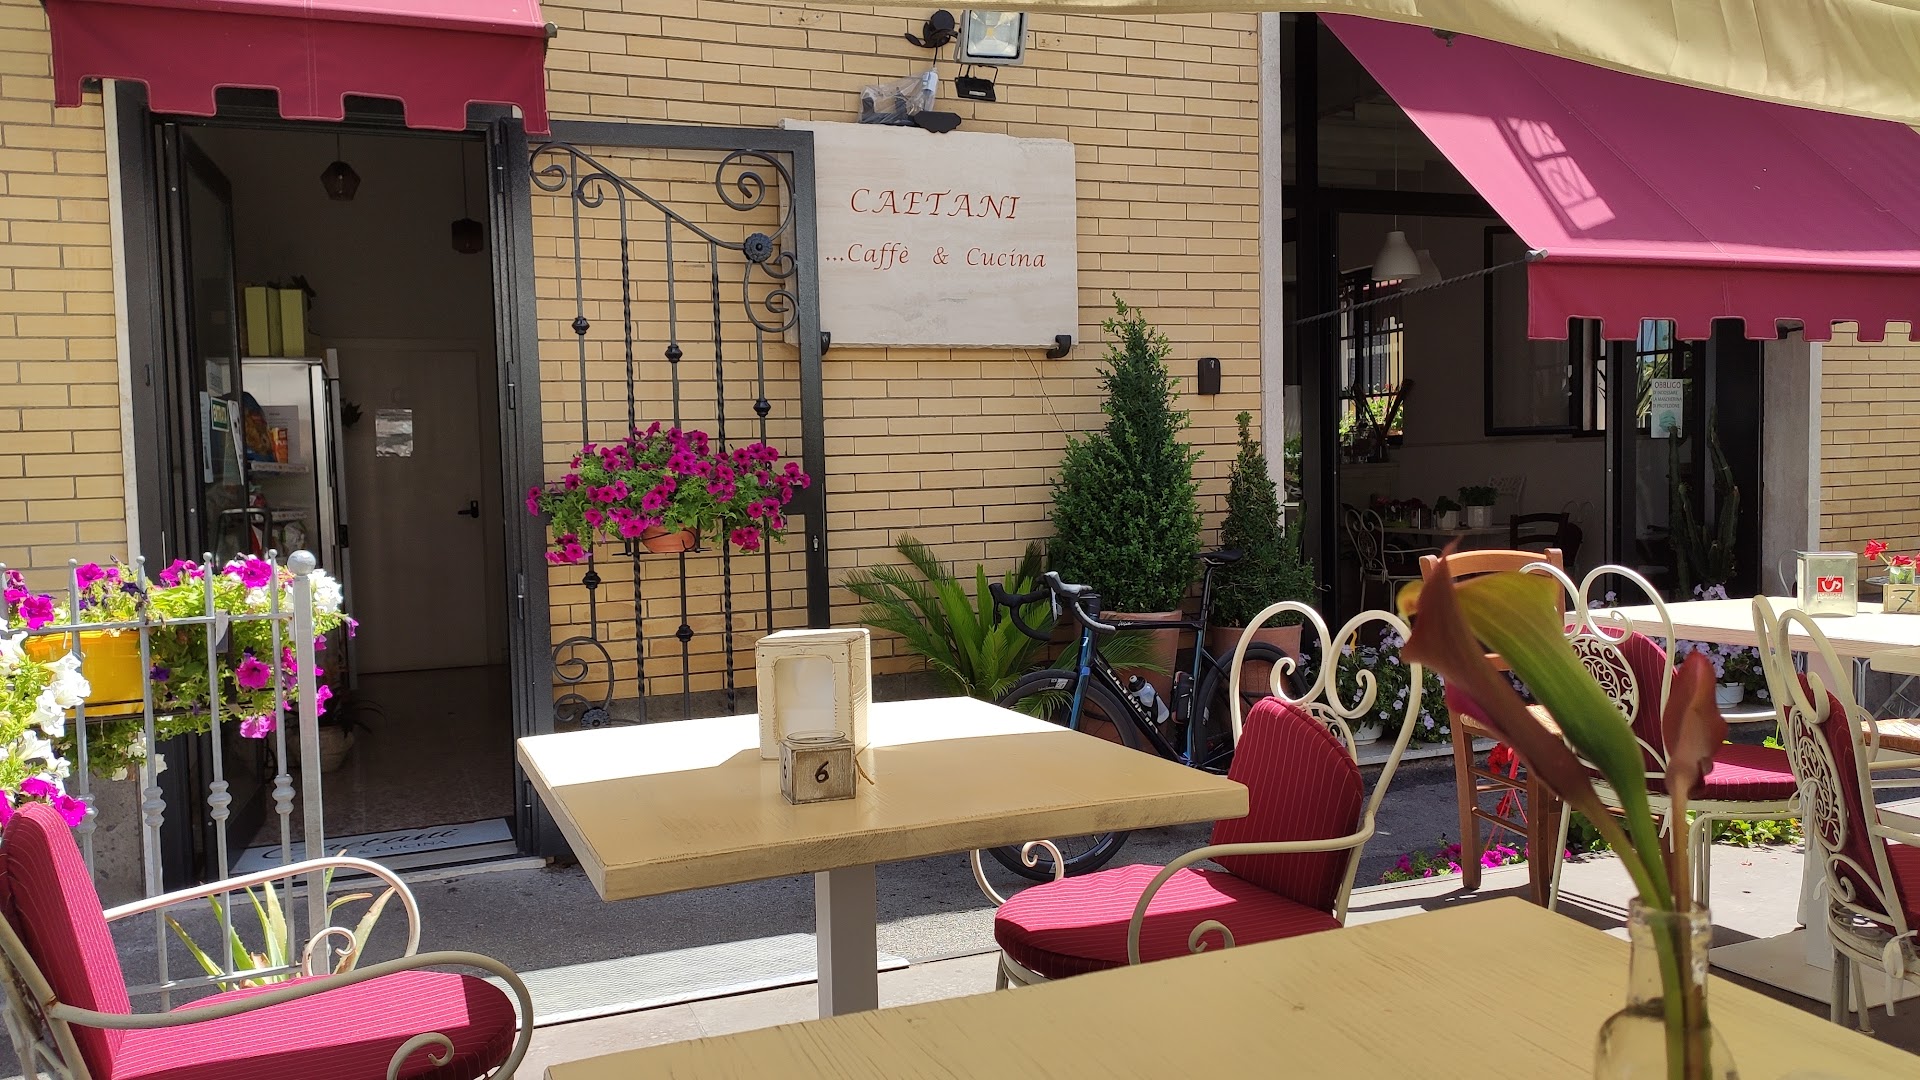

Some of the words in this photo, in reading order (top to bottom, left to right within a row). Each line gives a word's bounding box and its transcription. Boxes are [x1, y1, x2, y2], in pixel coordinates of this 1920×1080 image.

[851, 188, 1020, 219] CAETANI
[933, 246, 949, 265] &
[966, 247, 1047, 268] Cucina
[1654, 381, 1681, 389] OBBLIGO
[1892, 589, 1917, 612] 7
[814, 761, 829, 783] 6
